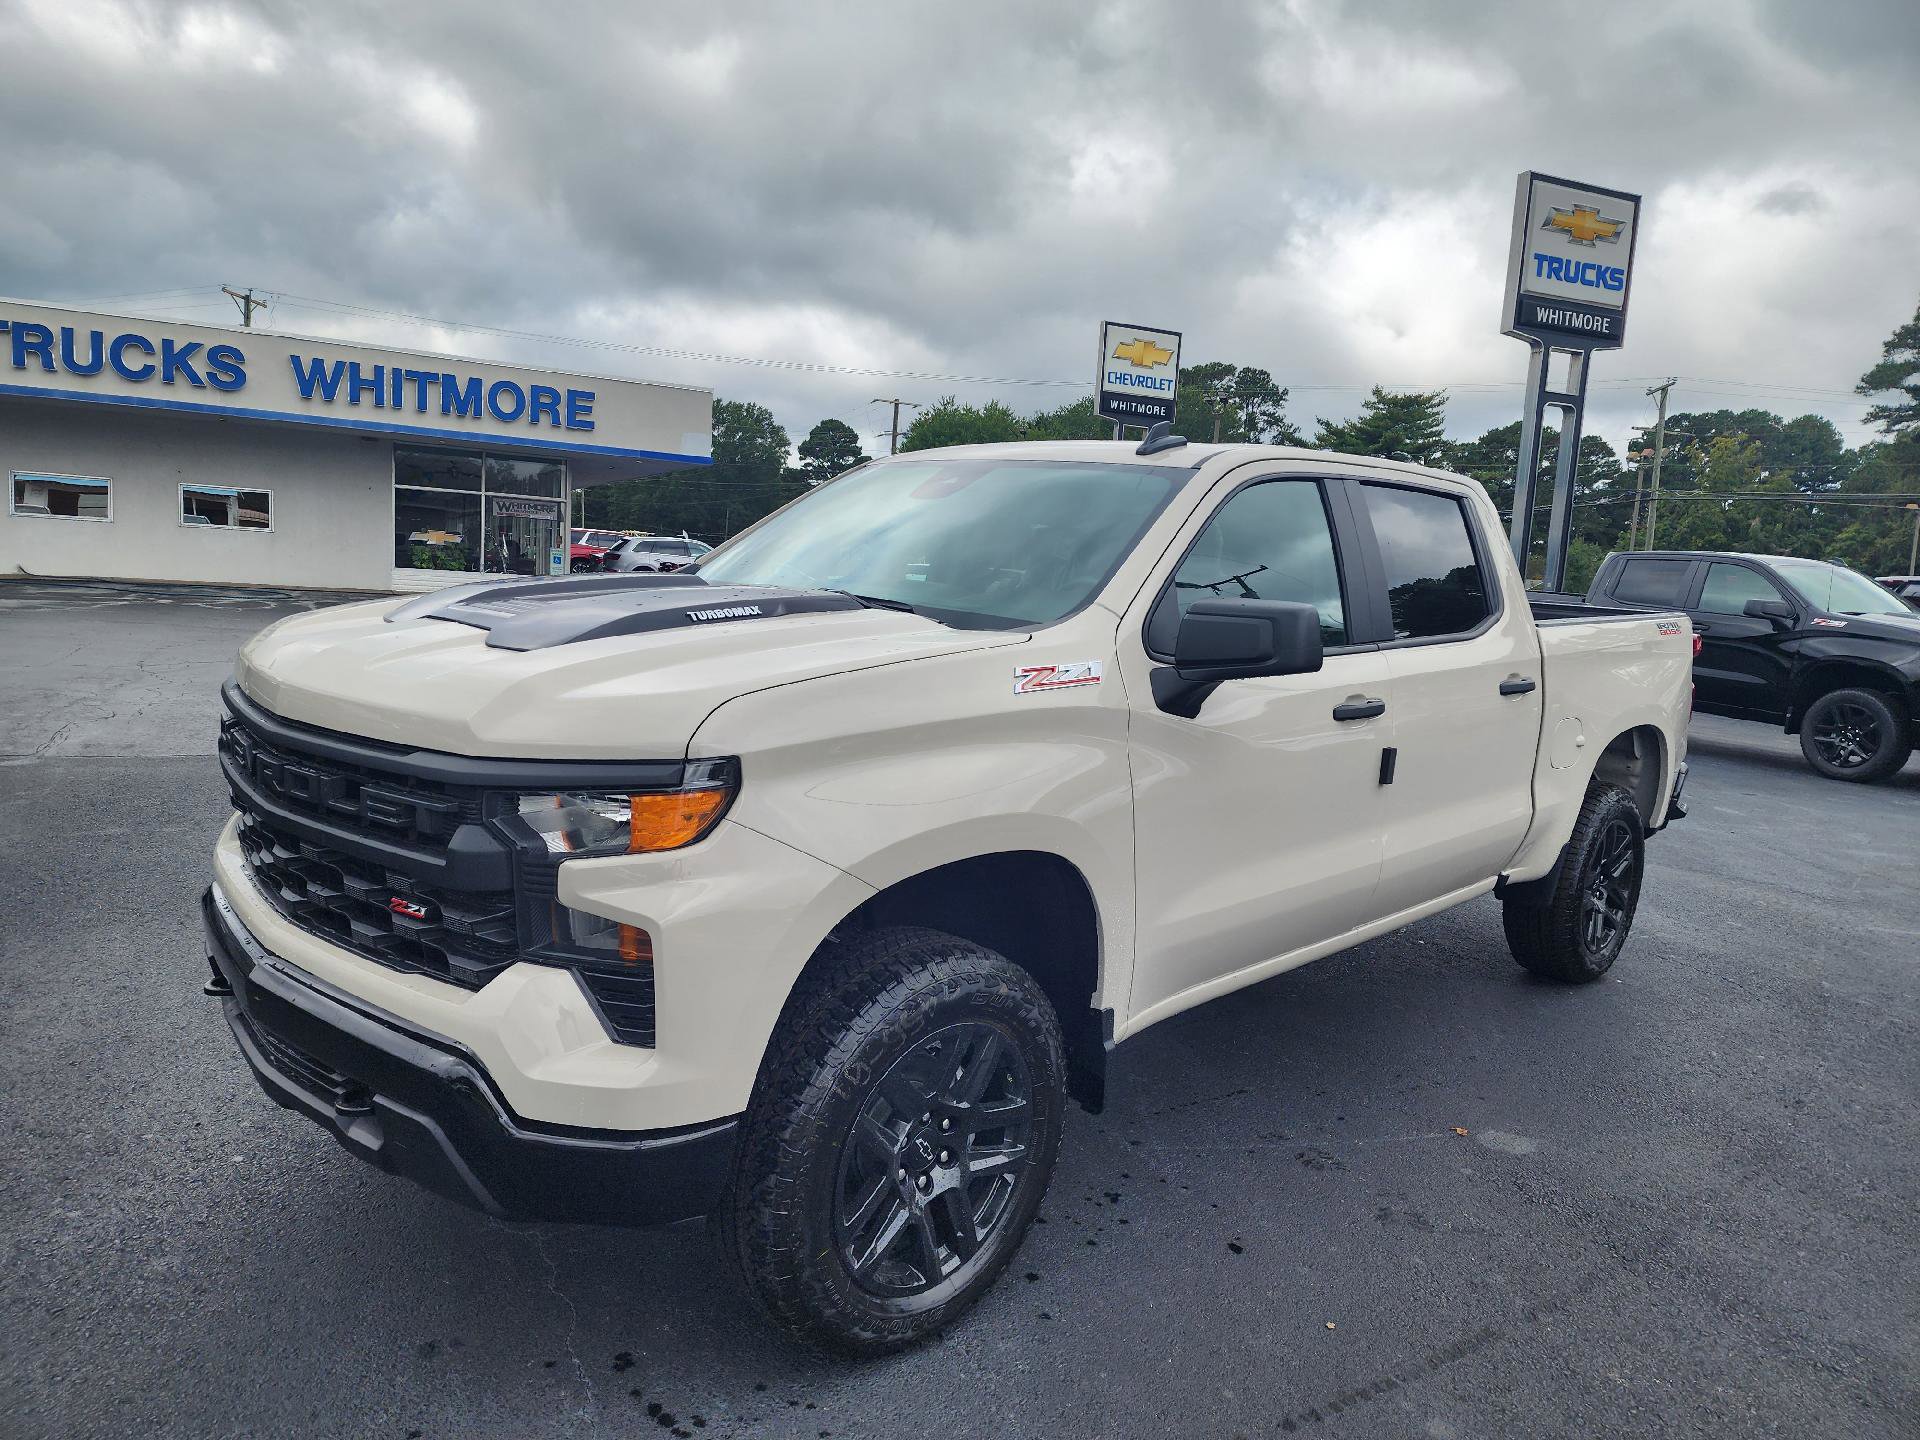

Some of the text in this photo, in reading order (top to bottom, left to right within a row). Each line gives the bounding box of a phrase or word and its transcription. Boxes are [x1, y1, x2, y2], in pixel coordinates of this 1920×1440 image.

[1534, 252, 1625, 291] TRUCKS
[1536, 306, 1611, 333] WHITMORE
[289, 354, 597, 431] WHITMORE
[1107, 371, 1174, 391] CHEVROLET
[1110, 399, 1167, 416] WHITMORE
[686, 605, 763, 622] TURBOMAX
[1014, 660, 1103, 695] Z71
[389, 896, 428, 919] Z71
